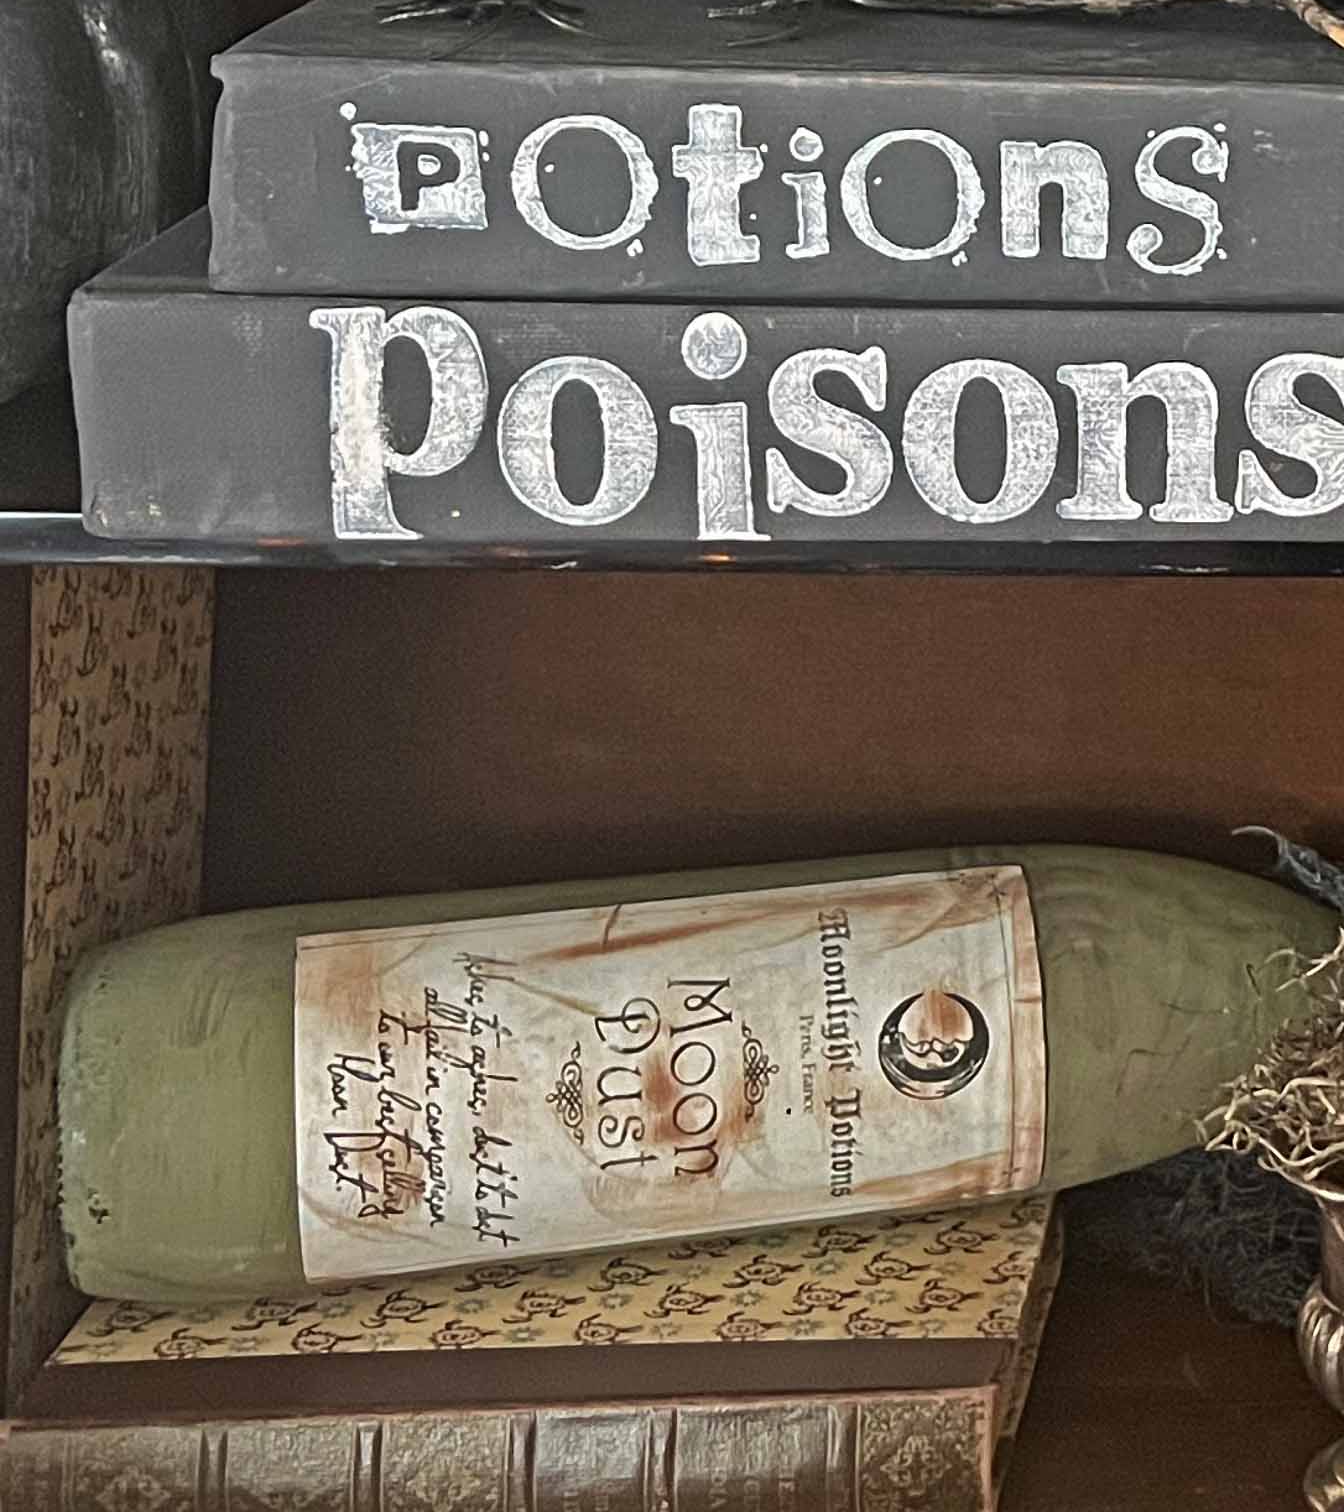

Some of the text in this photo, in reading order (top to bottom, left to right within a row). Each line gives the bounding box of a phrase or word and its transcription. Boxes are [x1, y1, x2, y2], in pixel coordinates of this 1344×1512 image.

[594, 996, 661, 1172] Dust
[667, 977, 733, 1177] Moon
[818, 907, 864, 1199] Moonlight Potions
